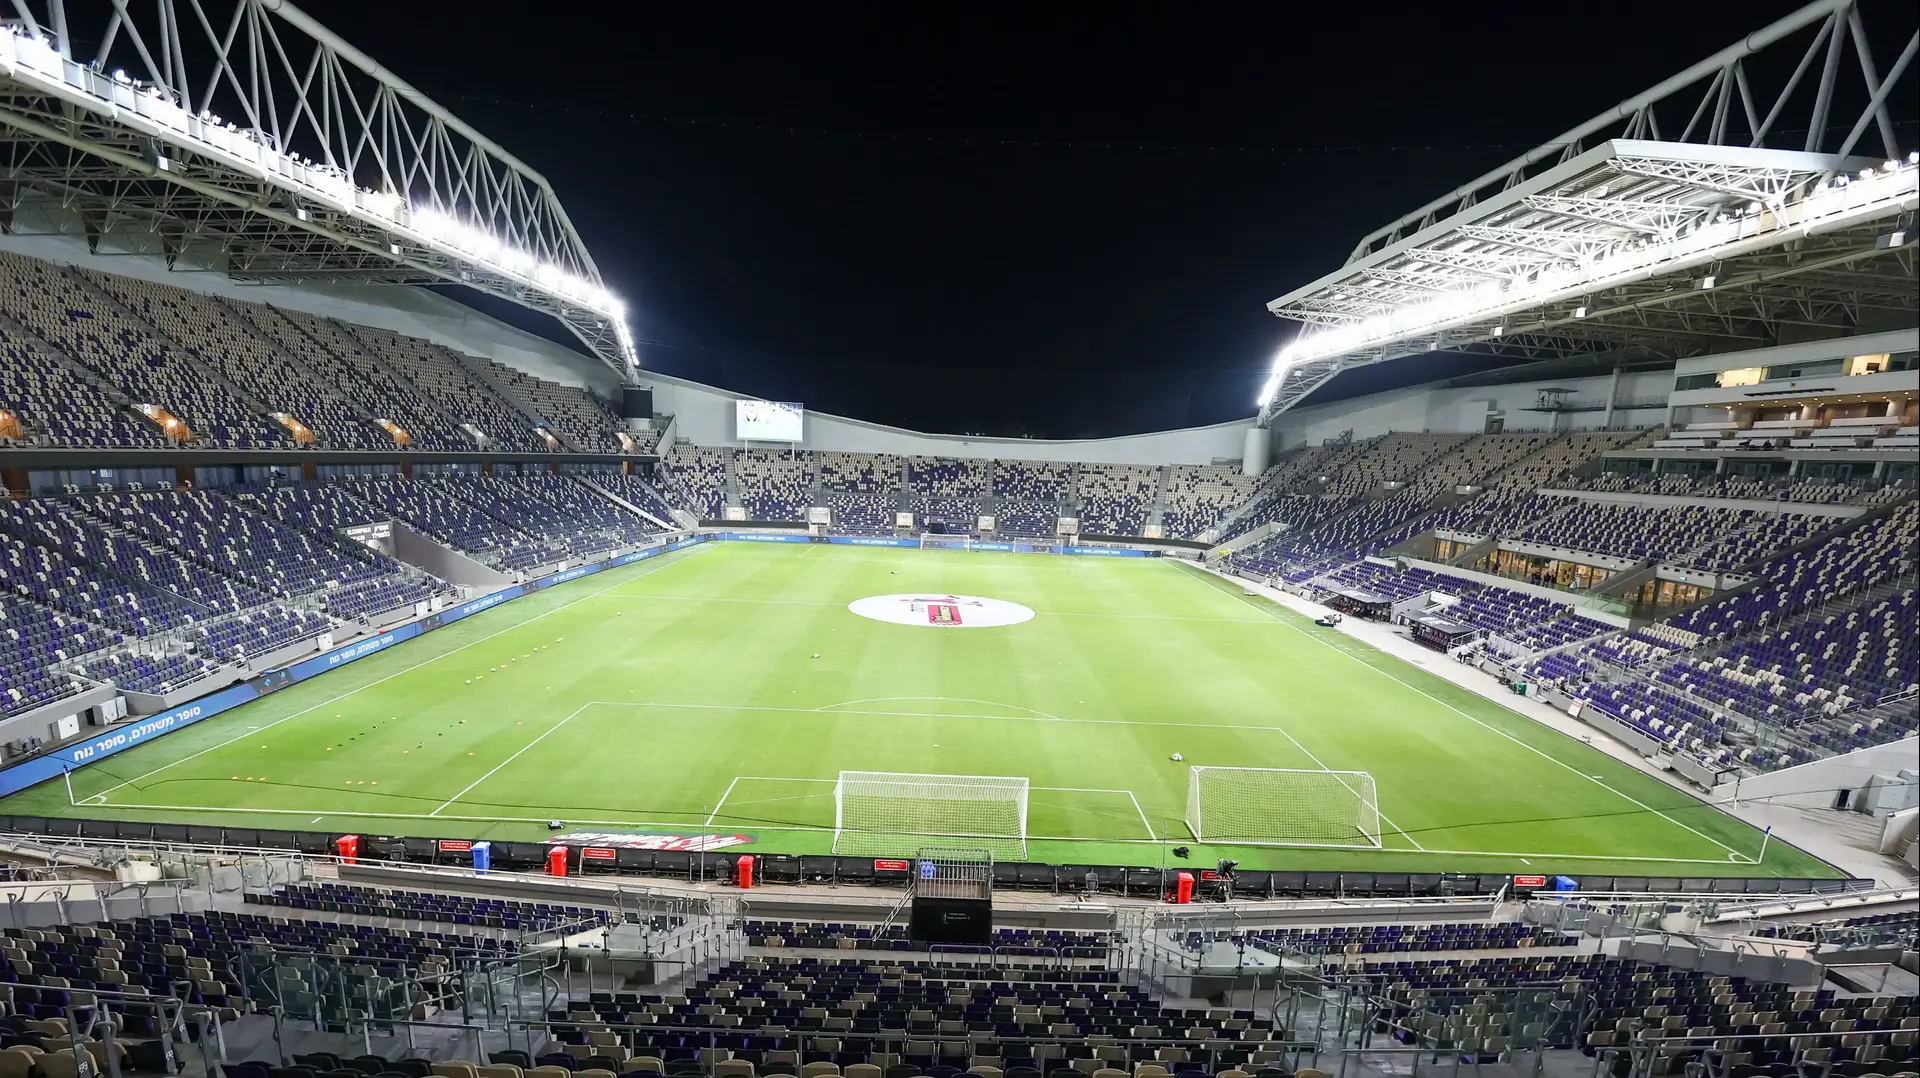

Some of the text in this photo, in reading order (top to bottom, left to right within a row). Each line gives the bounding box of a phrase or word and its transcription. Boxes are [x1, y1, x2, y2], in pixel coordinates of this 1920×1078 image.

[74, 706, 201, 761] סופר משתלם, סופר נוח
